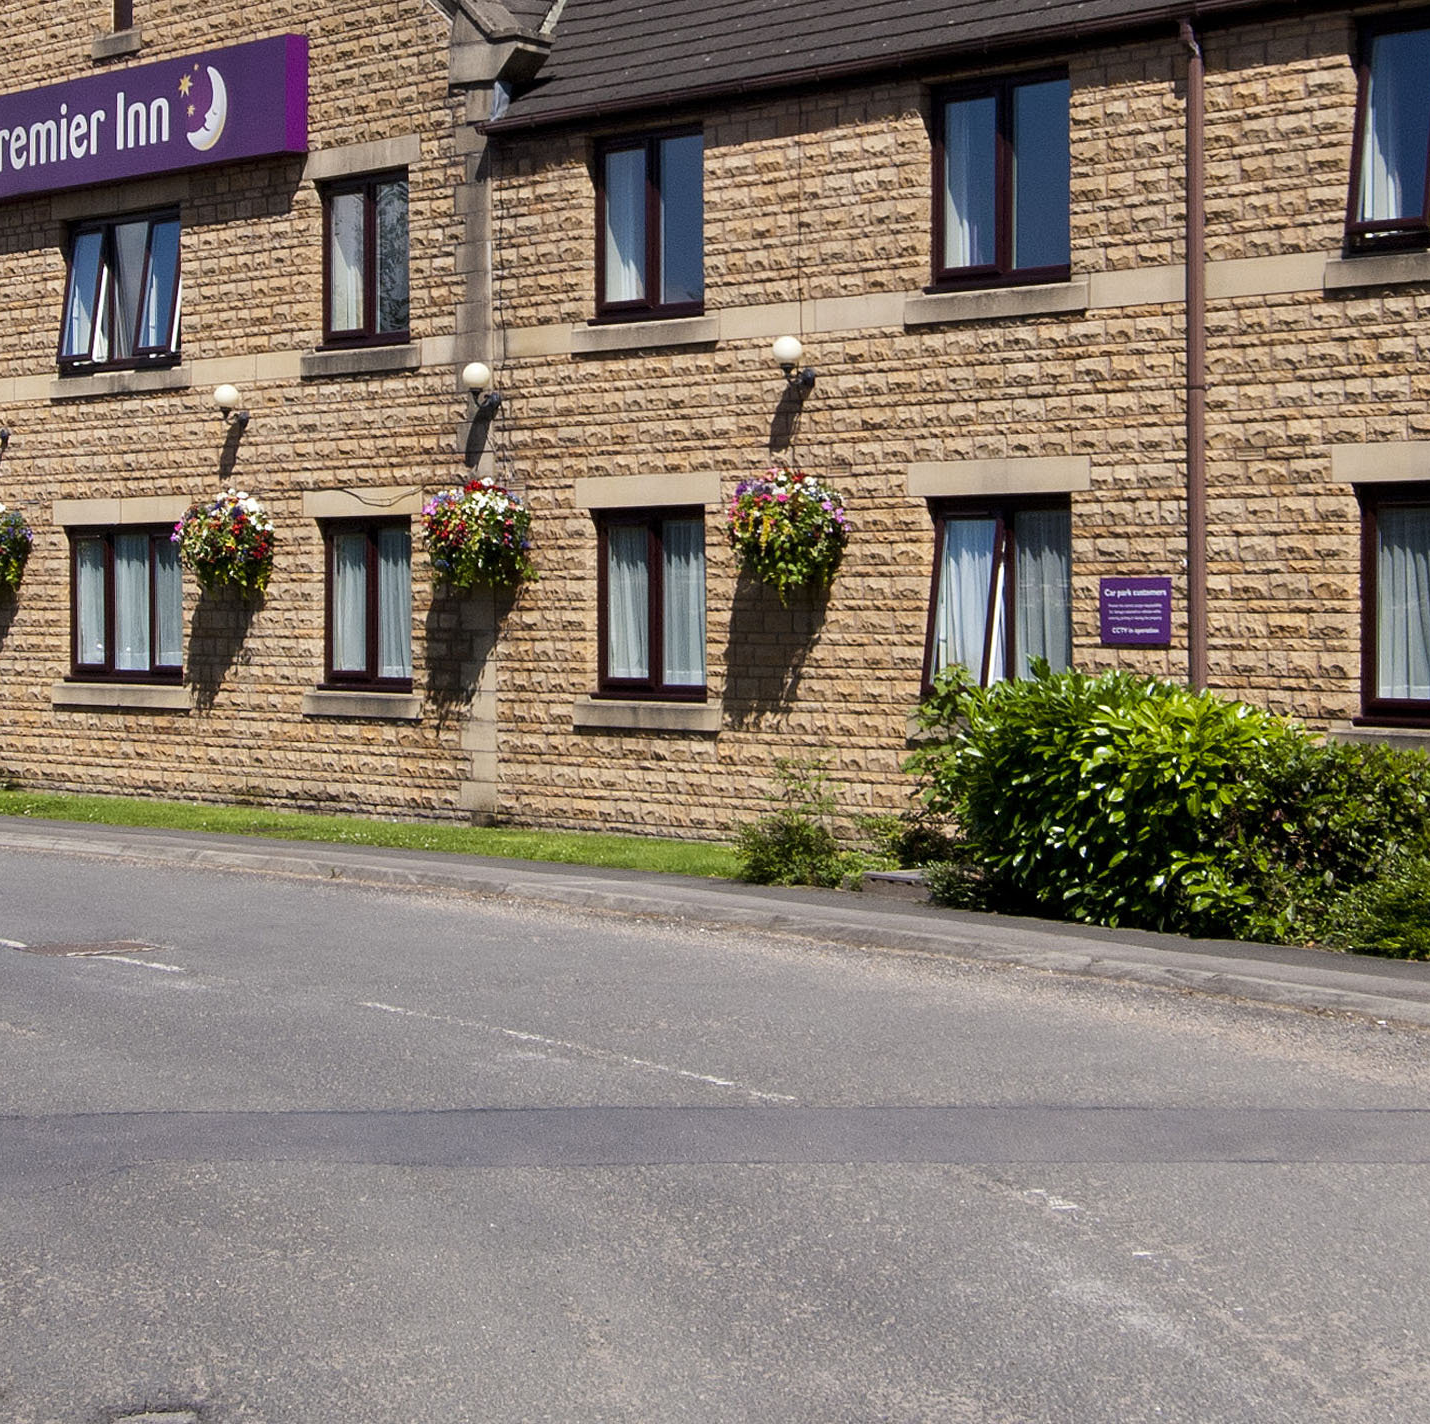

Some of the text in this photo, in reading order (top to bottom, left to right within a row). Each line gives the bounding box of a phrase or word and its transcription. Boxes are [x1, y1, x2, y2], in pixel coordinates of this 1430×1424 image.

[116, 92, 170, 150] Inn
[1104, 588, 1116, 597] Car
[1117, 588, 1131, 598] park
